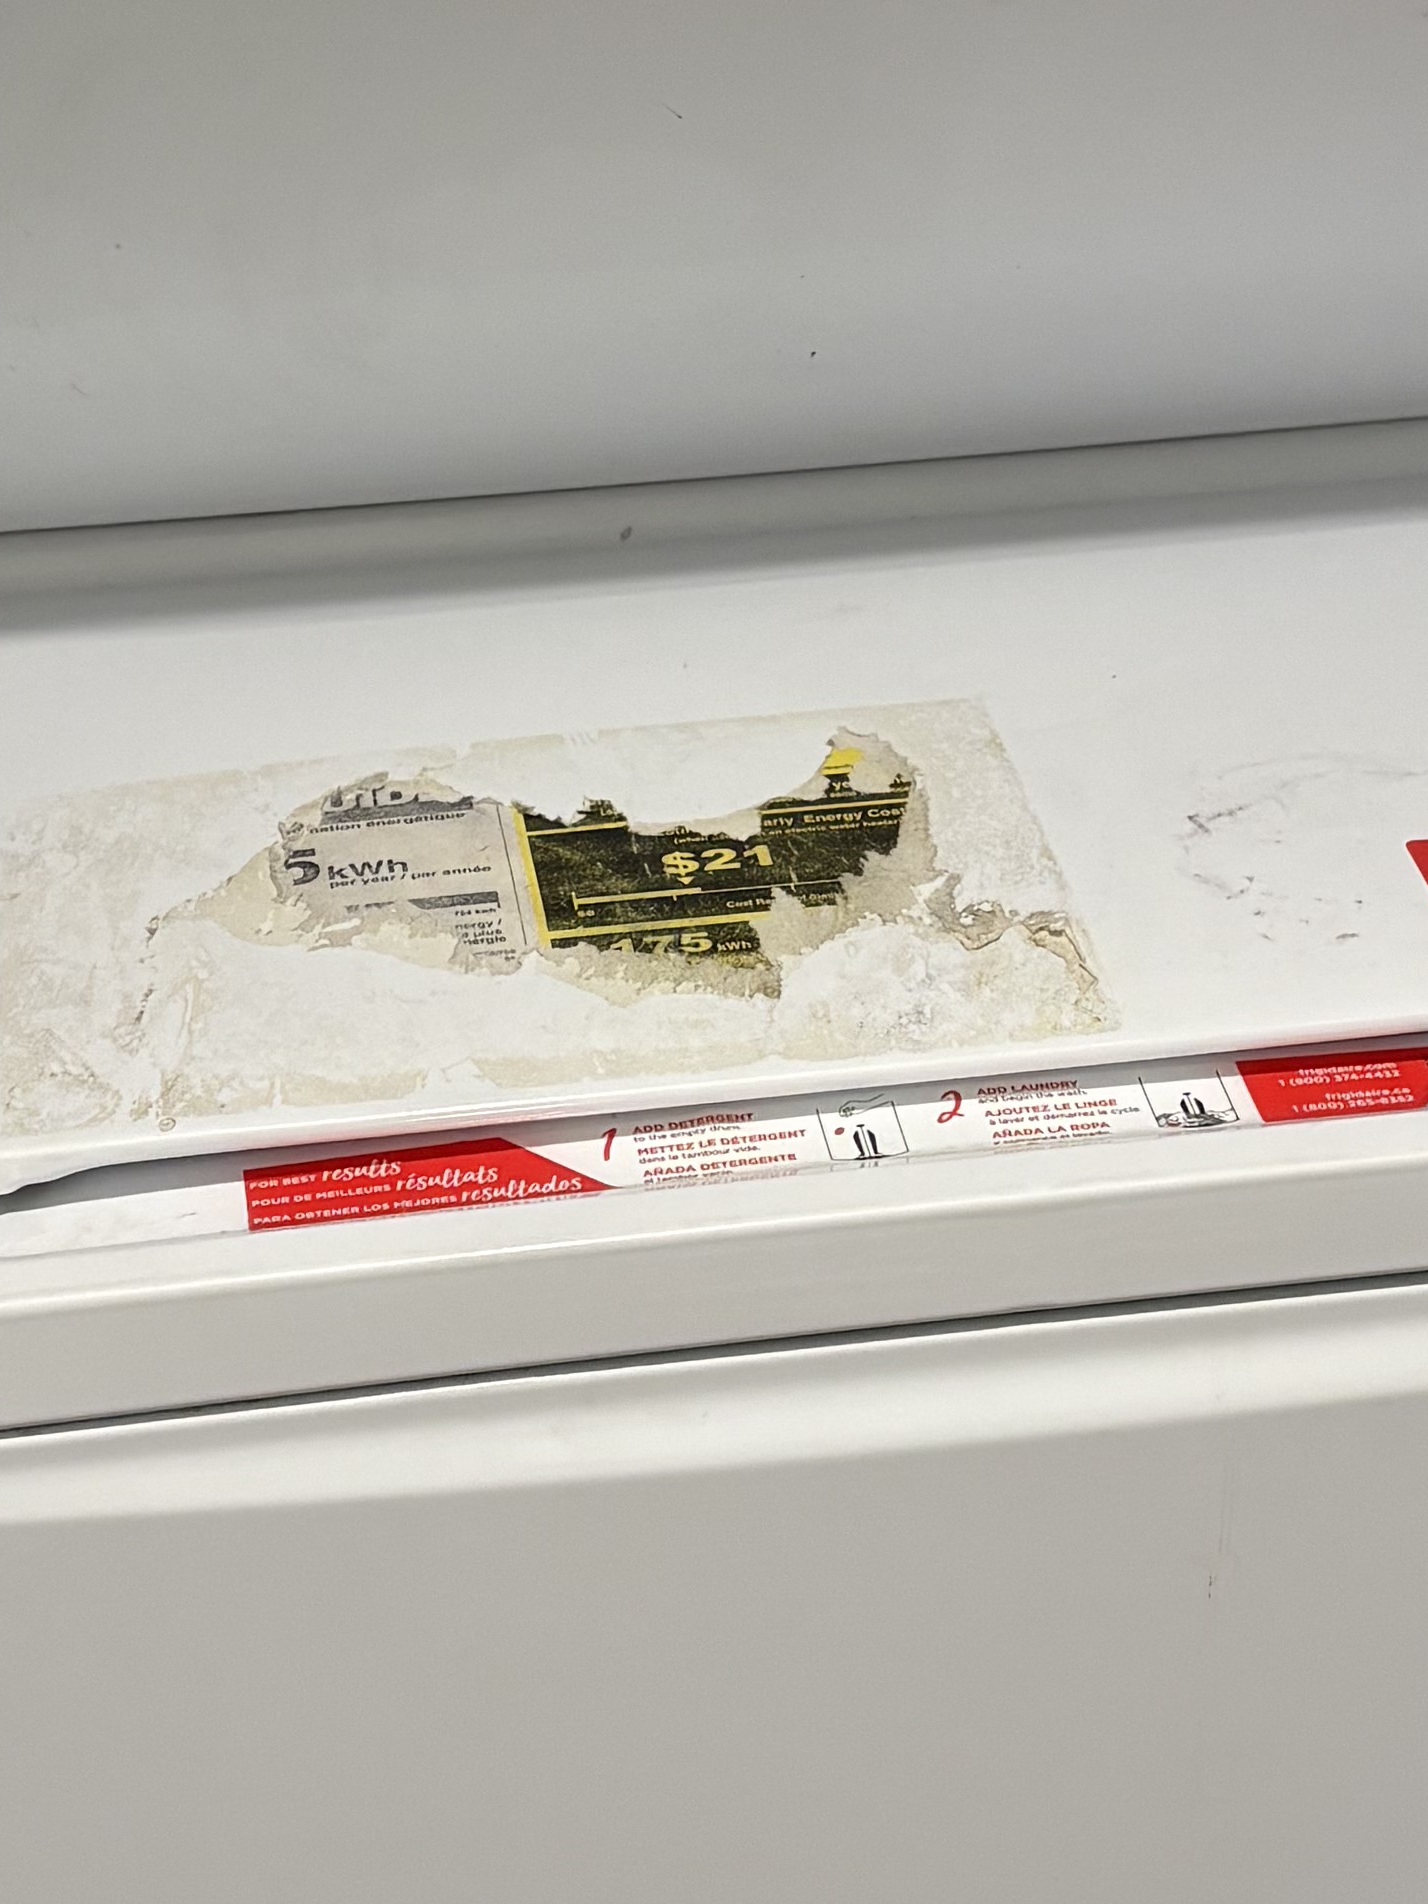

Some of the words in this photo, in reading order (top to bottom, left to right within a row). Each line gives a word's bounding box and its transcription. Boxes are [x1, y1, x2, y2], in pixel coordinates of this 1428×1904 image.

[804, 810, 862, 824] Energy
[327, 859, 408, 880] kWh
[330, 878, 356, 890] per
[362, 875, 395, 887] year
[977, 1086, 1007, 1096] ADD
[1011, 1080, 1078, 1092] LAUNDRY
[936, 1090, 964, 1123] 2
[985, 1104, 1050, 1117] AJOUTEZ
[1076, 1099, 1117, 1109] LINGE
[633, 1124, 664, 1134] ADD
[668, 1113, 754, 1131] DETERGENT
[1071, 1121, 1110, 1131] ROPA
[602, 1127, 617, 1161] 1
[249, 1180, 278, 1190] FOR
[282, 1174, 316, 1186] BEST
[322, 1159, 401, 1181] results
[252, 1196, 290, 1207] POUR
[294, 1193, 312, 1202] DE
[316, 1184, 391, 1199] MEILLEURS
[396, 1165, 498, 1192] résultats
[253, 1214, 291, 1224] PARA
[295, 1206, 359, 1220] OBTENER
[364, 1203, 389, 1212] LOS
[393, 1194, 458, 1209] MEJORES
[462, 1175, 582, 1202] resultados
